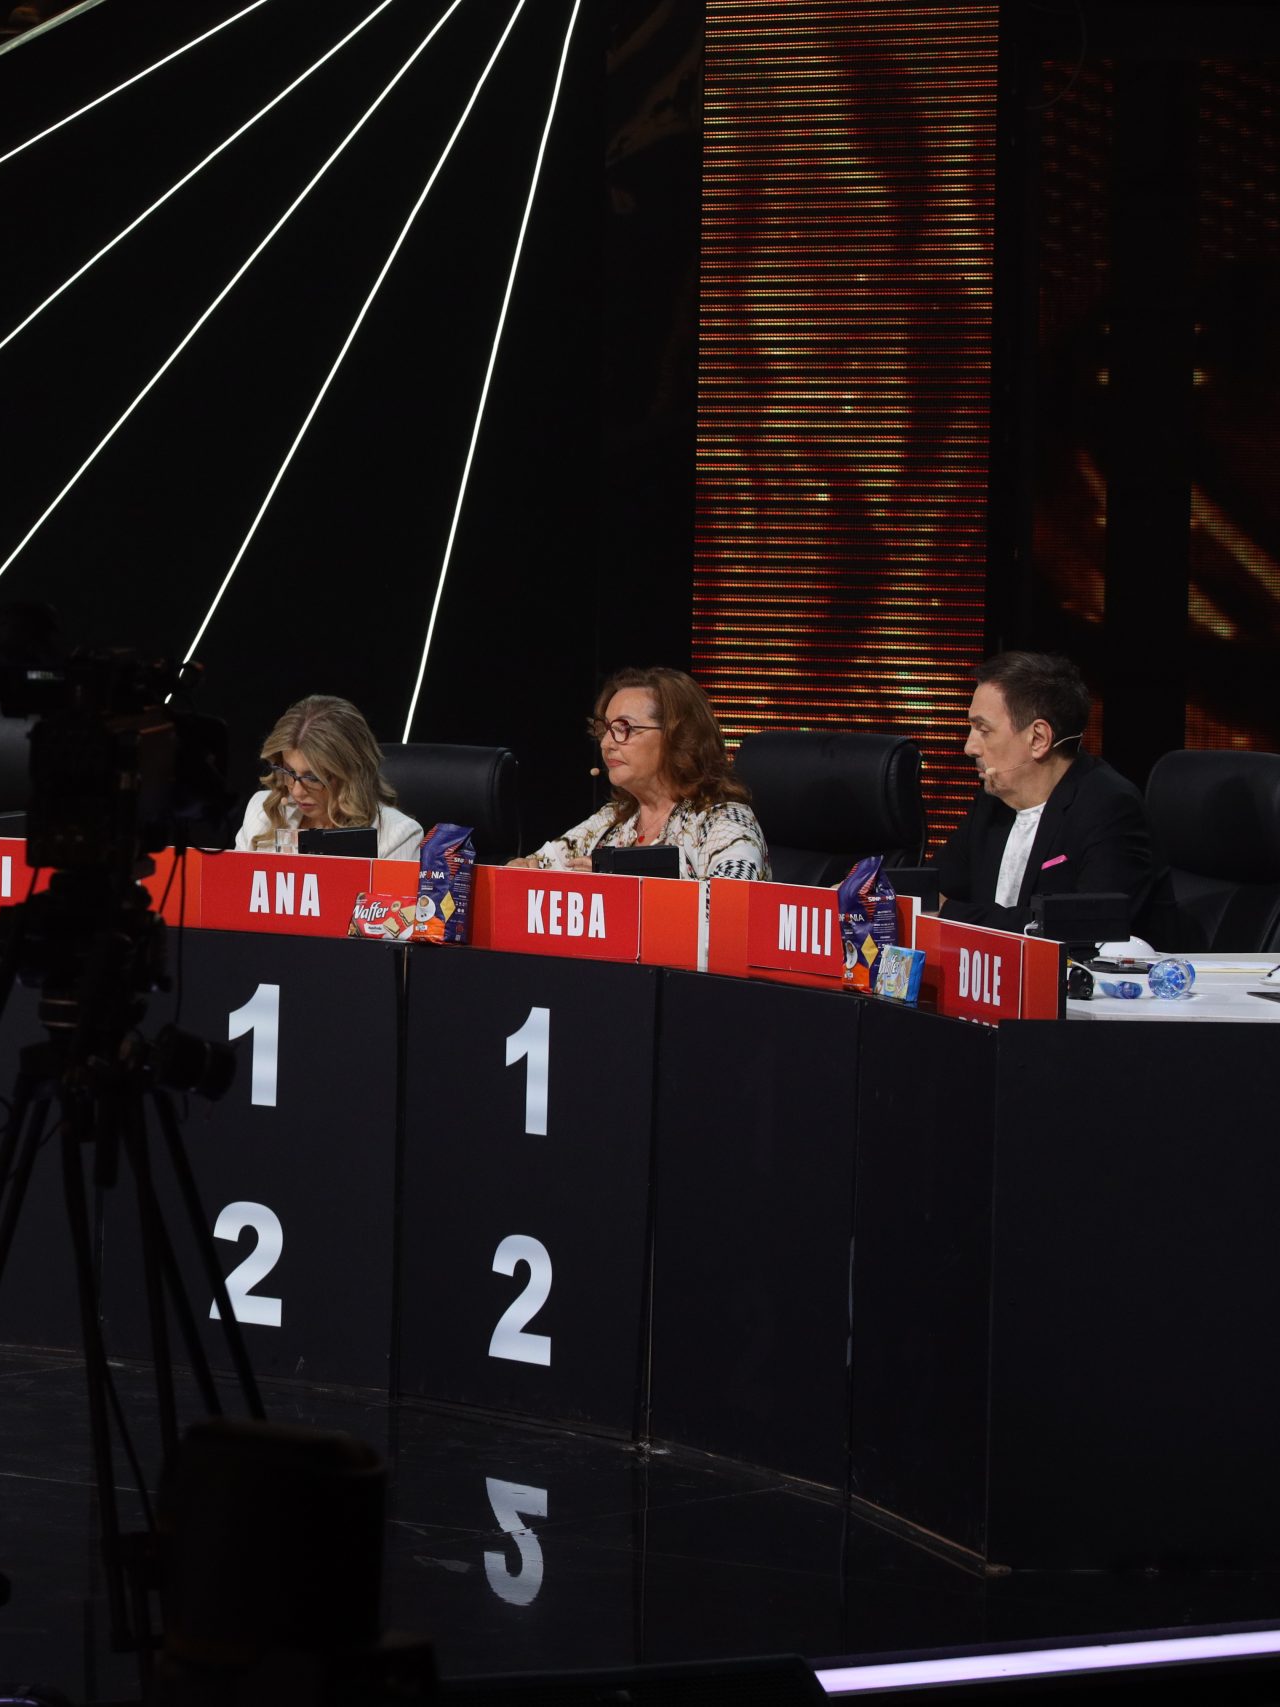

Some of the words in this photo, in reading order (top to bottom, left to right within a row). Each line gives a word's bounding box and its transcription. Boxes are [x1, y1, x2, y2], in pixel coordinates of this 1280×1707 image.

[249, 870, 320, 917] ANA
[527, 889, 606, 939] KEBA
[778, 903, 832, 957] MILI
[228, 983, 280, 1107] 1
[505, 1006, 551, 1136] 1
[209, 1201, 284, 1327] 2
[488, 1234, 553, 1367] 2
